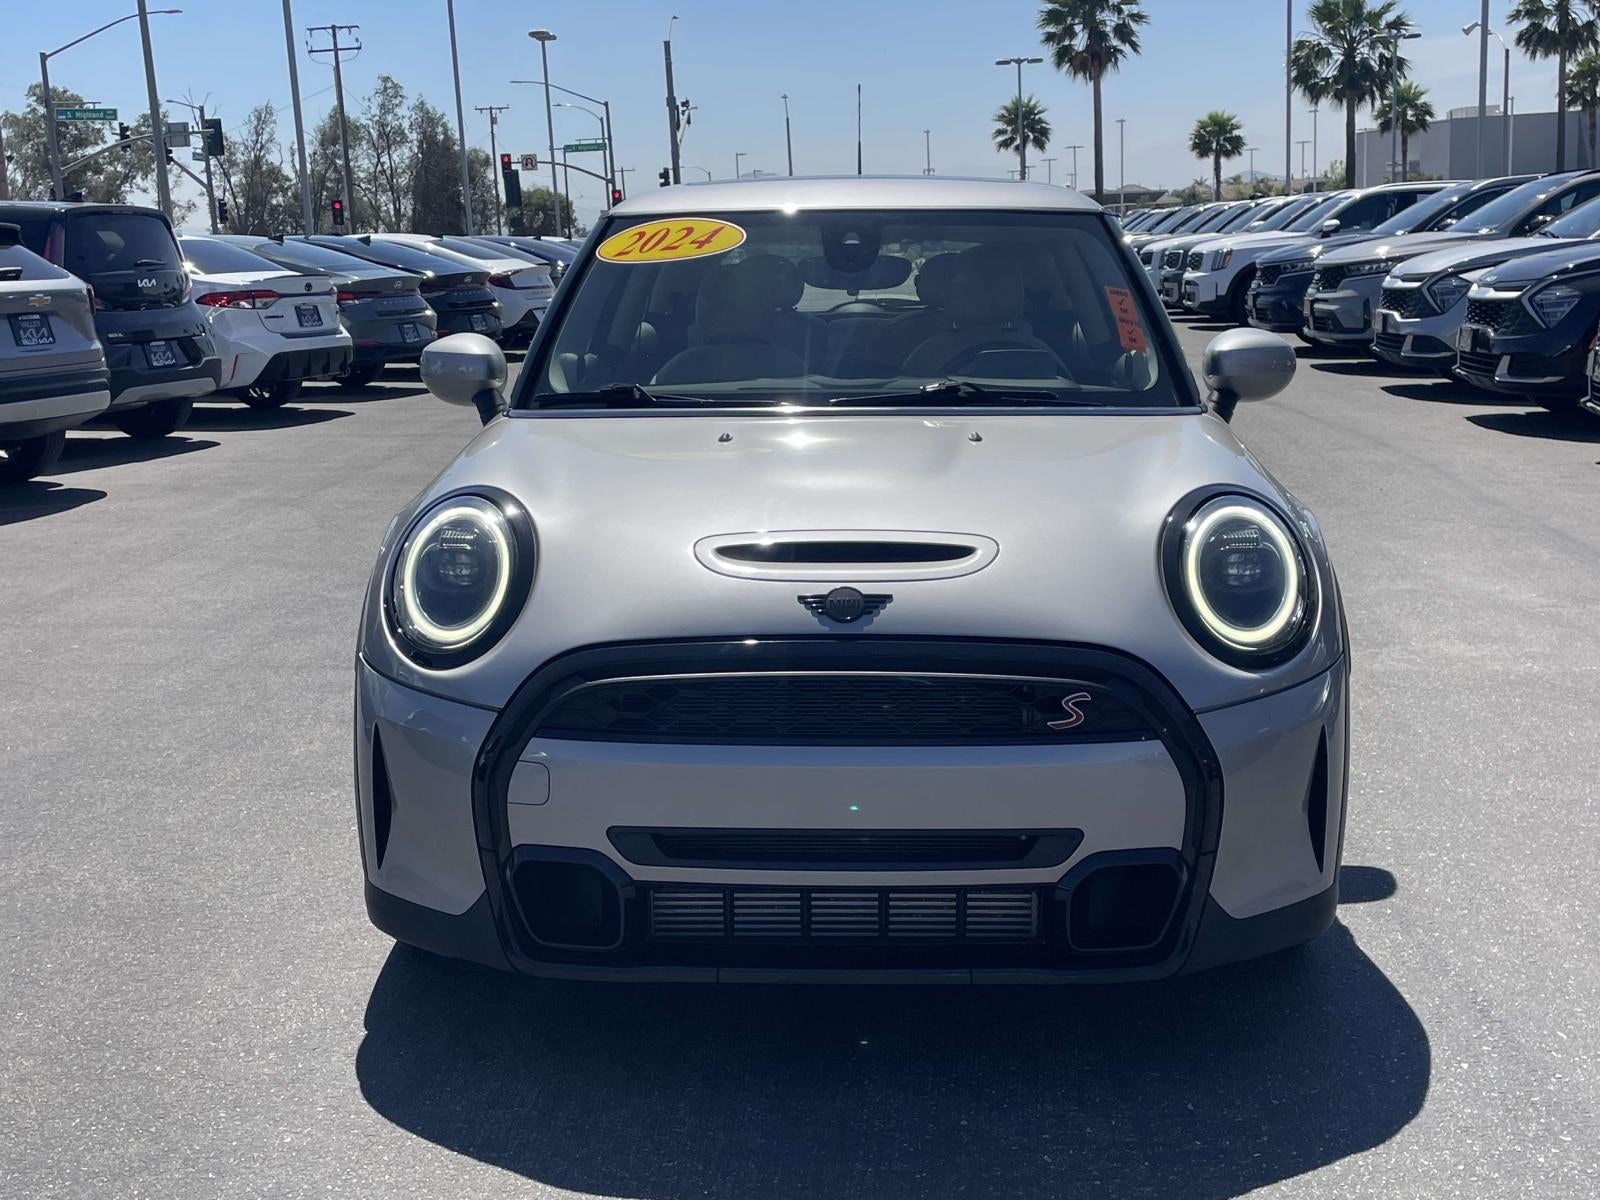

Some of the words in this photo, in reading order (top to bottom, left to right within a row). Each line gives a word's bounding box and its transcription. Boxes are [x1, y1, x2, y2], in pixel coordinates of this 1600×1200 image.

[612, 225, 727, 258] 2024
[137, 278, 156, 288] KIA
[829, 598, 862, 609] MINI
[1046, 691, 1092, 730] S
